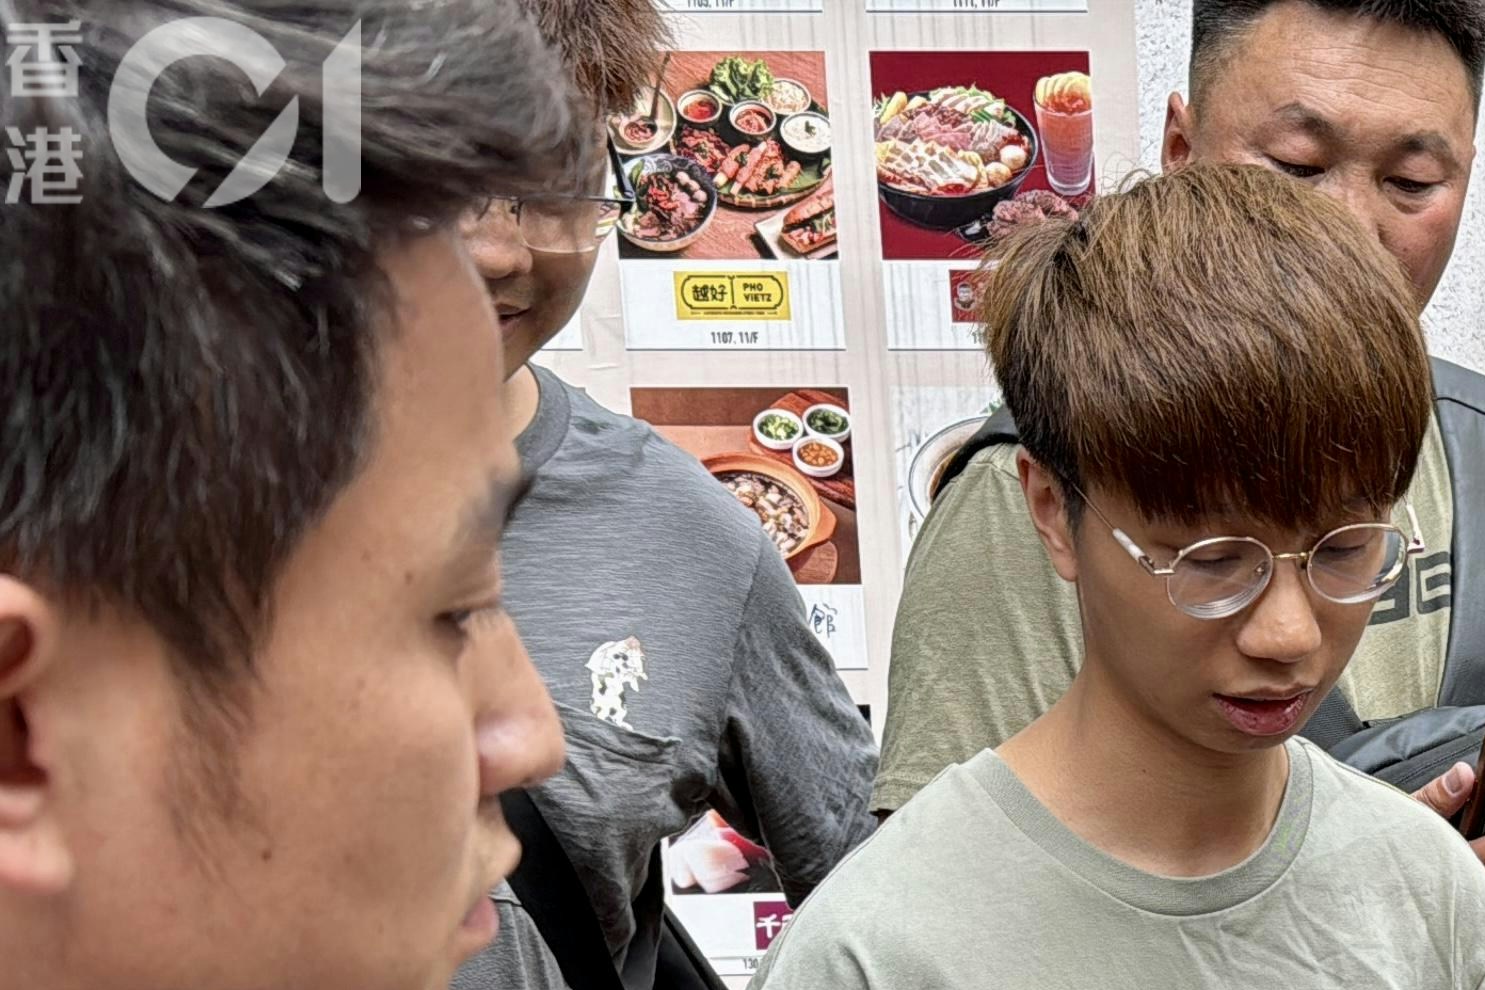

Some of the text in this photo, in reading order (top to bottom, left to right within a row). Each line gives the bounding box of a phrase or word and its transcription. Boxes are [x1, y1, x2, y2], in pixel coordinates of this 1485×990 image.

[743, 283, 763, 291] PHO
[711, 332, 758, 345] 1107, 11/F
